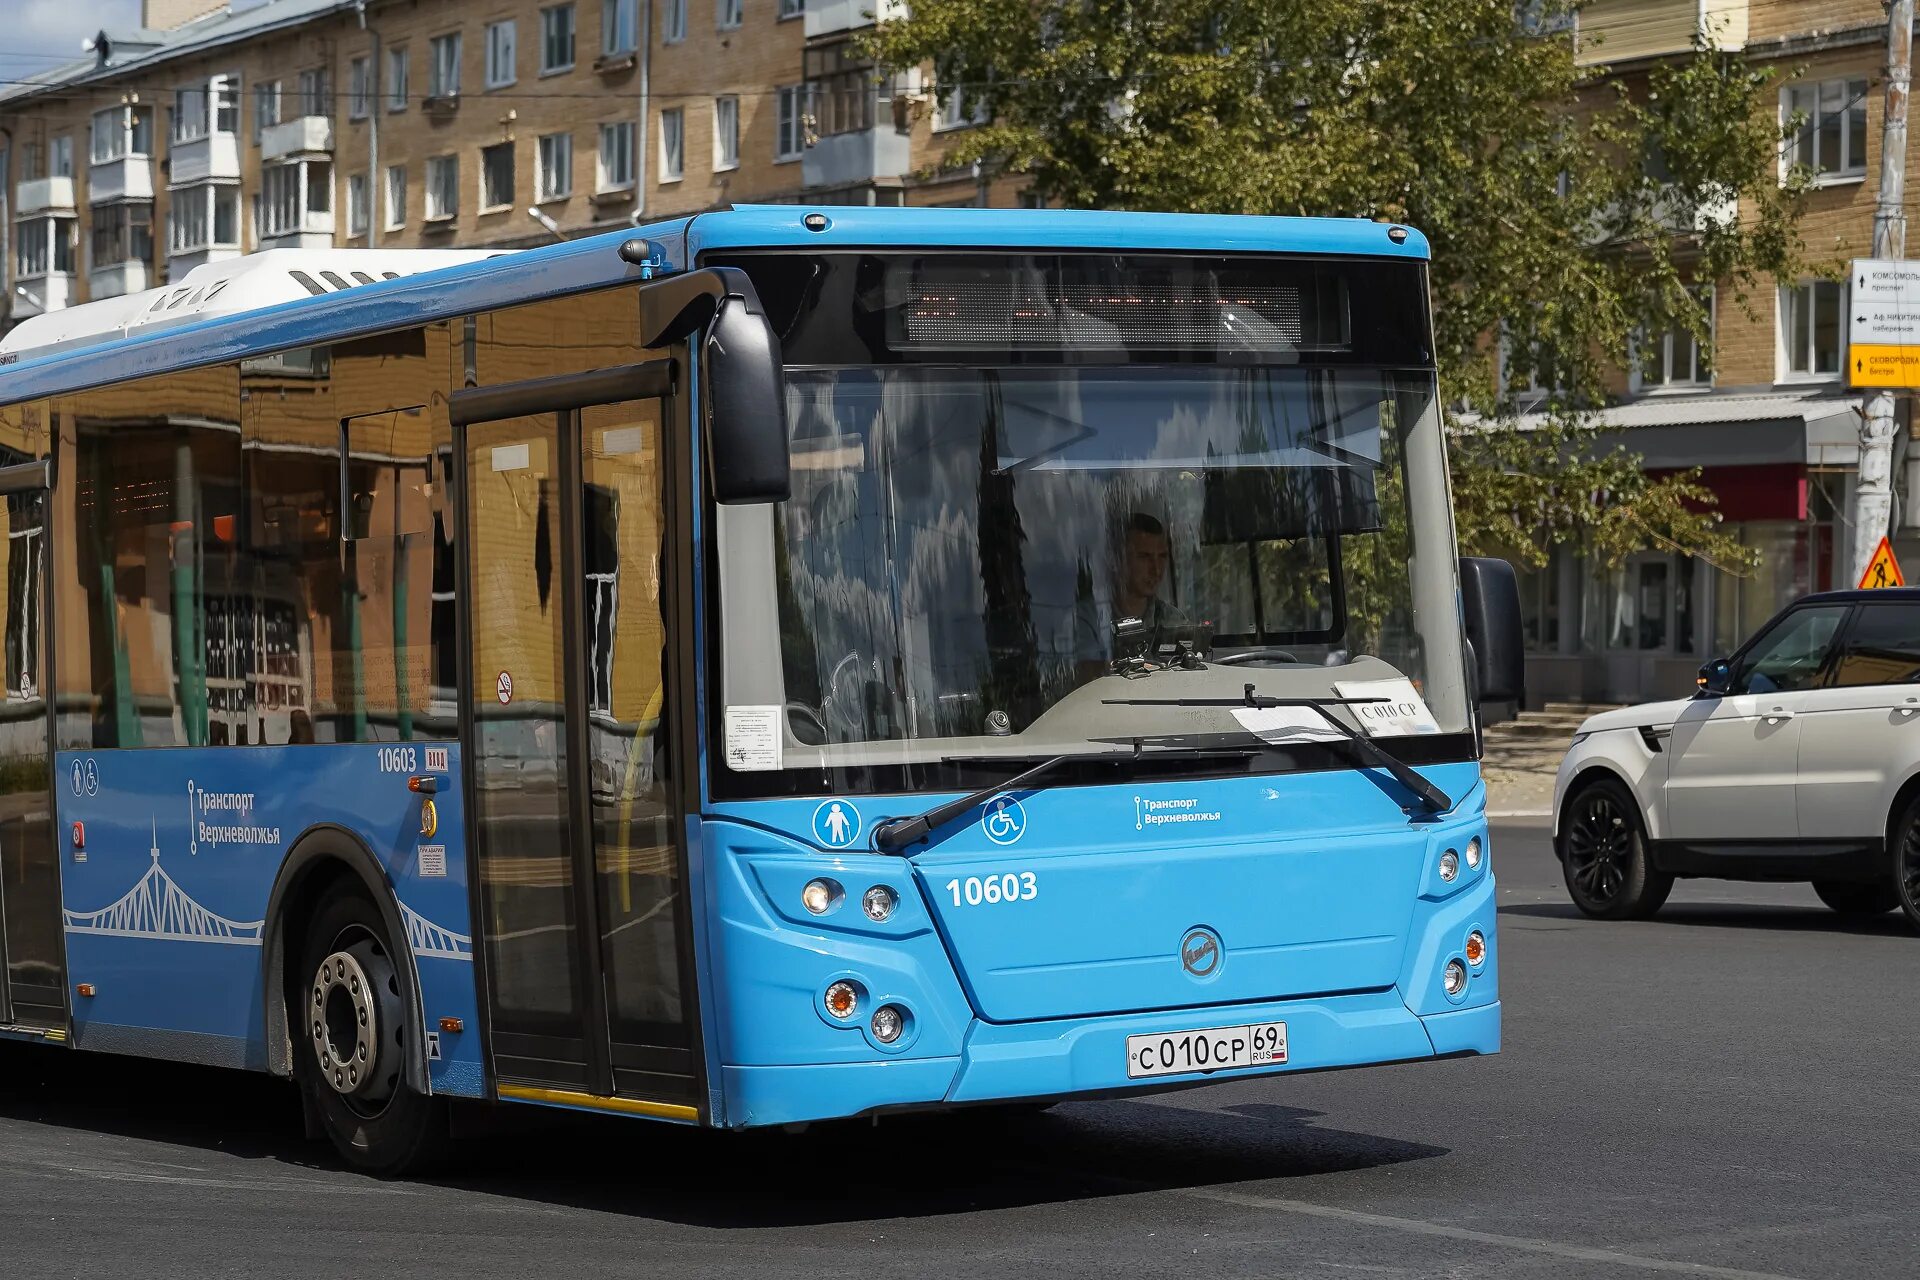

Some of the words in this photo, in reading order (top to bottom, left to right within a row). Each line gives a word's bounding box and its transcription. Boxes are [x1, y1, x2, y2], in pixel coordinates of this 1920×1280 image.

[1373, 704, 1398, 718] 010
[1398, 703, 1417, 717] СР
[377, 747, 417, 772] 10603
[428, 751, 445, 769] ВХОД
[197, 788, 255, 816] Транспорт
[1143, 798, 1198, 811] Транспорт
[1144, 811, 1221, 826] Верхневолжья
[199, 821, 280, 848] Верхневолжья
[945, 871, 1039, 907] 10603
[1253, 1026, 1278, 1051] 69
[1252, 1050, 1272, 1061] RUS
